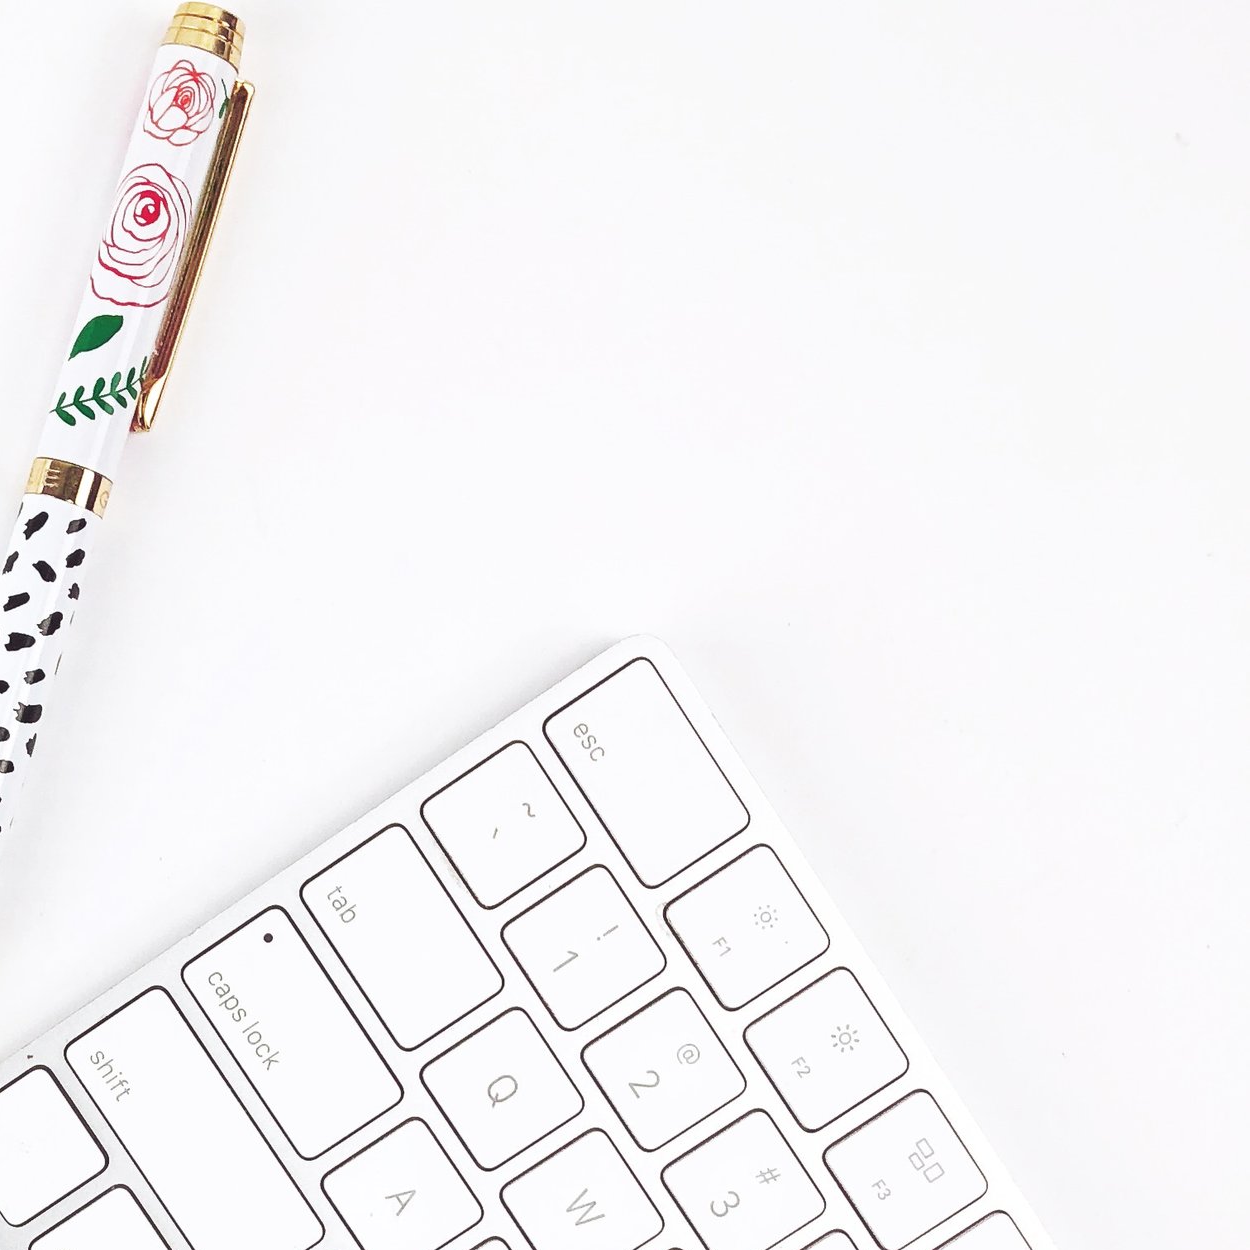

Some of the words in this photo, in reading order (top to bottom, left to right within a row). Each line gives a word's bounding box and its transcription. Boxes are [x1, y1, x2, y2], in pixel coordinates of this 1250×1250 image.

[572, 722, 606, 763] esc
[326, 885, 358, 925] tab
[552, 949, 580, 974] 1
[711, 935, 733, 958] F1
[207, 970, 248, 1023] caps
[241, 1020, 281, 1072] lock
[89, 1050, 132, 1103] shift
[790, 1055, 812, 1079] F2
[486, 1073, 520, 1110] Q
[627, 1068, 662, 1100] 2
[383, 1188, 418, 1218] A
[709, 1189, 742, 1219] 3
[870, 1178, 892, 1201] F3
[564, 1187, 607, 1228] W
